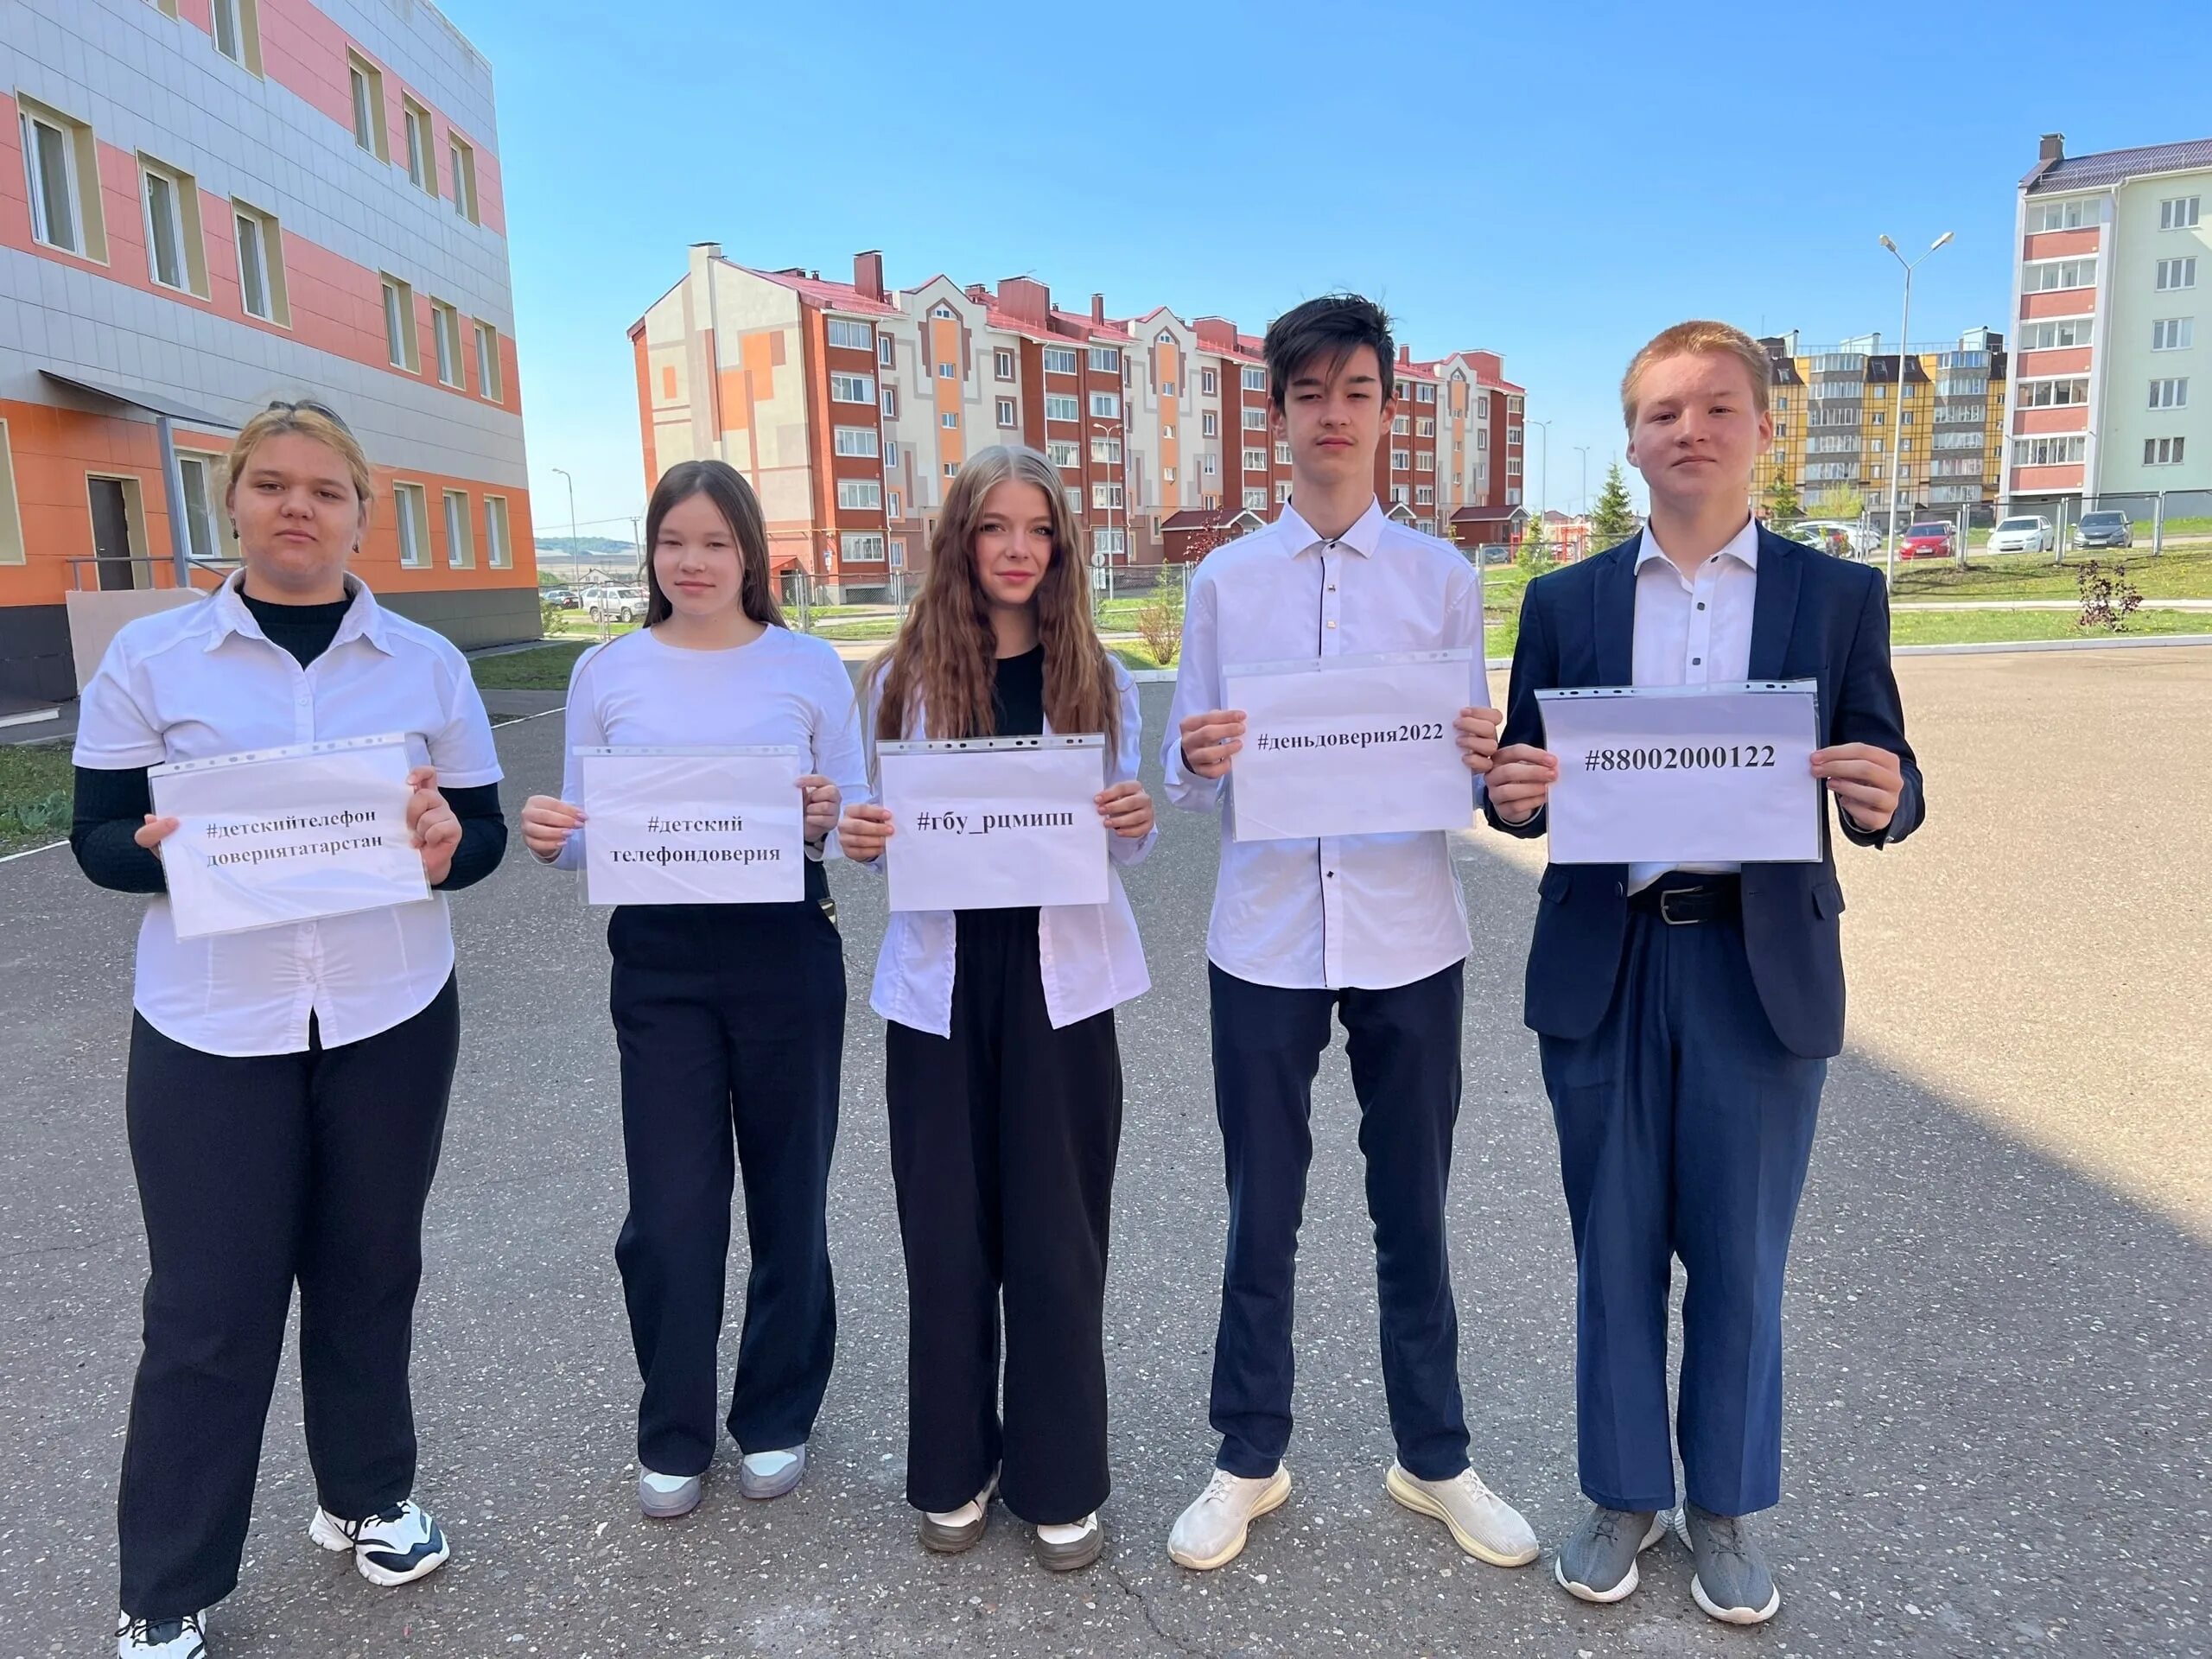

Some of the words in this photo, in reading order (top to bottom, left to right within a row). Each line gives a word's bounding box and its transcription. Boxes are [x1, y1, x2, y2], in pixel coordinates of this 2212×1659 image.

[1257, 722, 1444, 751] #деньдоверия2022
[1585, 745, 1776, 772] #88002000122
[207, 810, 377, 839] #детскийтелефон
[646, 815, 744, 834] #детский
[916, 810, 1073, 836] #гбу_рцмипп
[207, 835, 383, 868] довериятатарстан
[609, 845, 781, 867] телефондоверия
